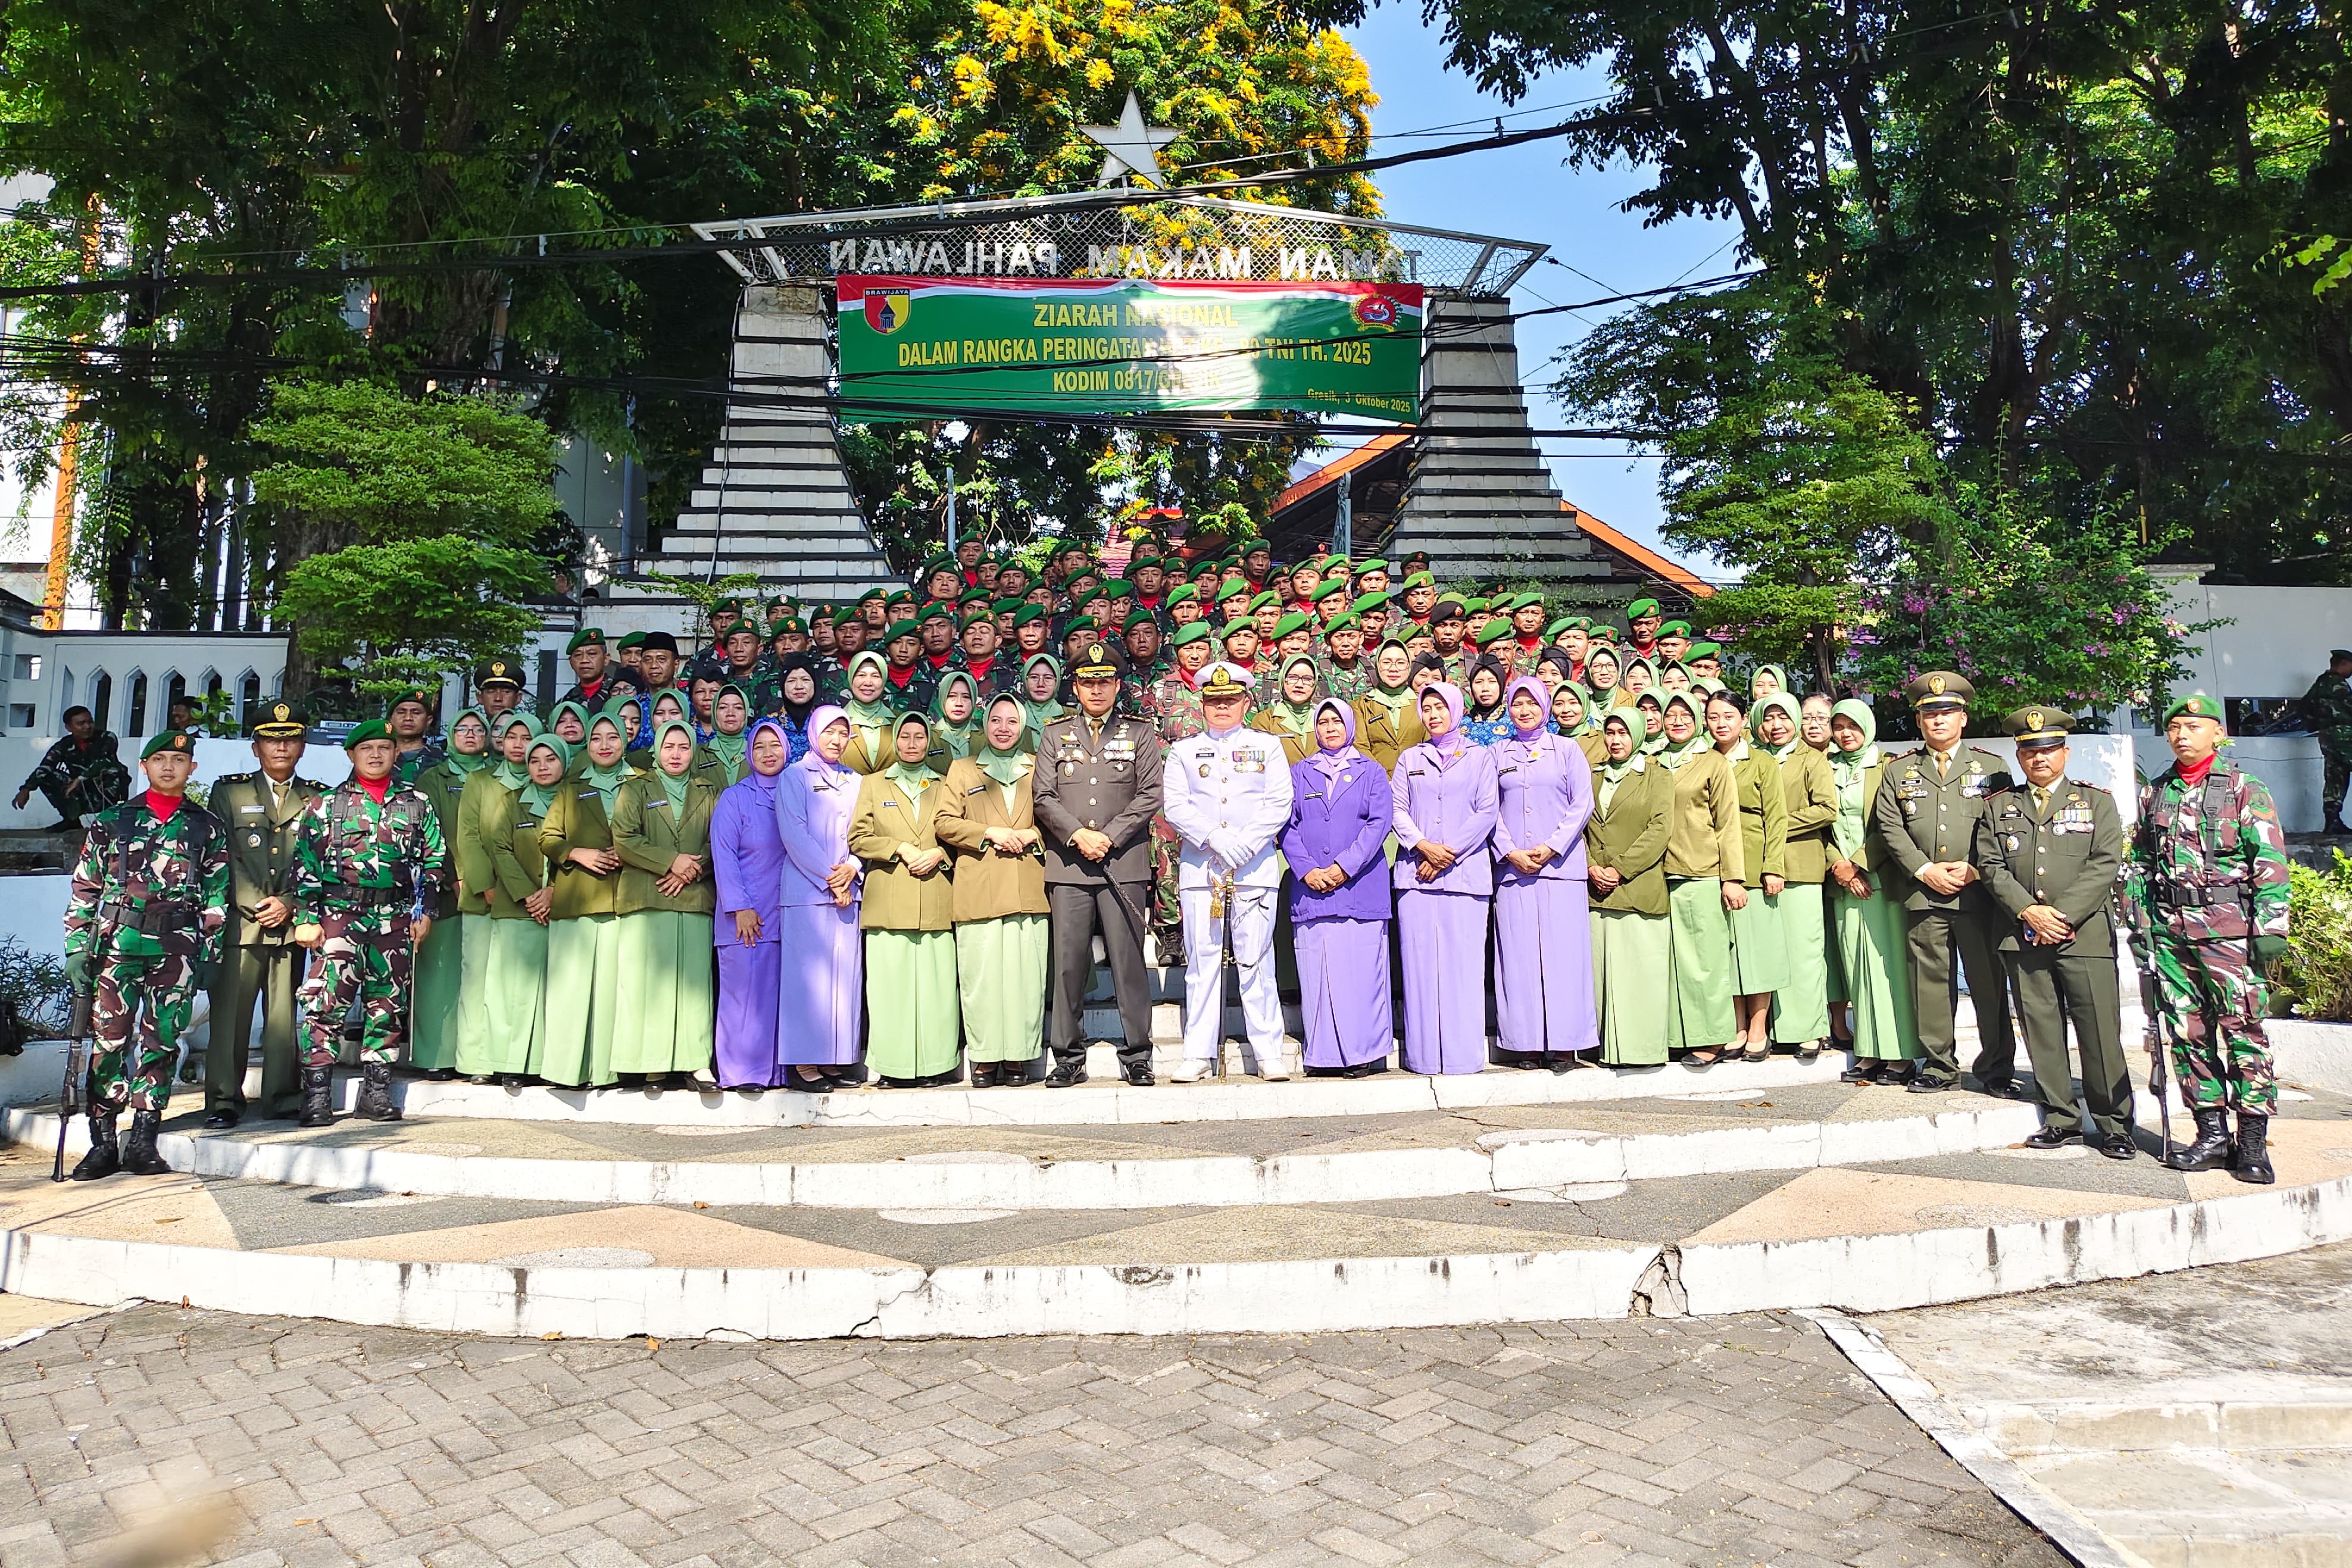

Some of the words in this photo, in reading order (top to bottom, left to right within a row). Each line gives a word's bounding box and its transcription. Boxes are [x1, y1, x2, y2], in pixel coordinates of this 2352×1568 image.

[1033, 304, 1118, 327] ZIARAH
[1125, 304, 1238, 327] NASIONAL
[899, 341, 957, 367] DALAM
[963, 338, 1038, 363] RANGKA
[1043, 337, 1154, 360] PERINGATAN
[1264, 338, 1295, 360] TNI
[1299, 338, 1328, 361] TH.
[1332, 341, 1371, 365] 2025
[1053, 370, 1109, 392] KODIM
[1345, 391, 1351, 404] 3
[1355, 393, 1389, 409] Oktober
[1391, 398, 1411, 413] 2025
